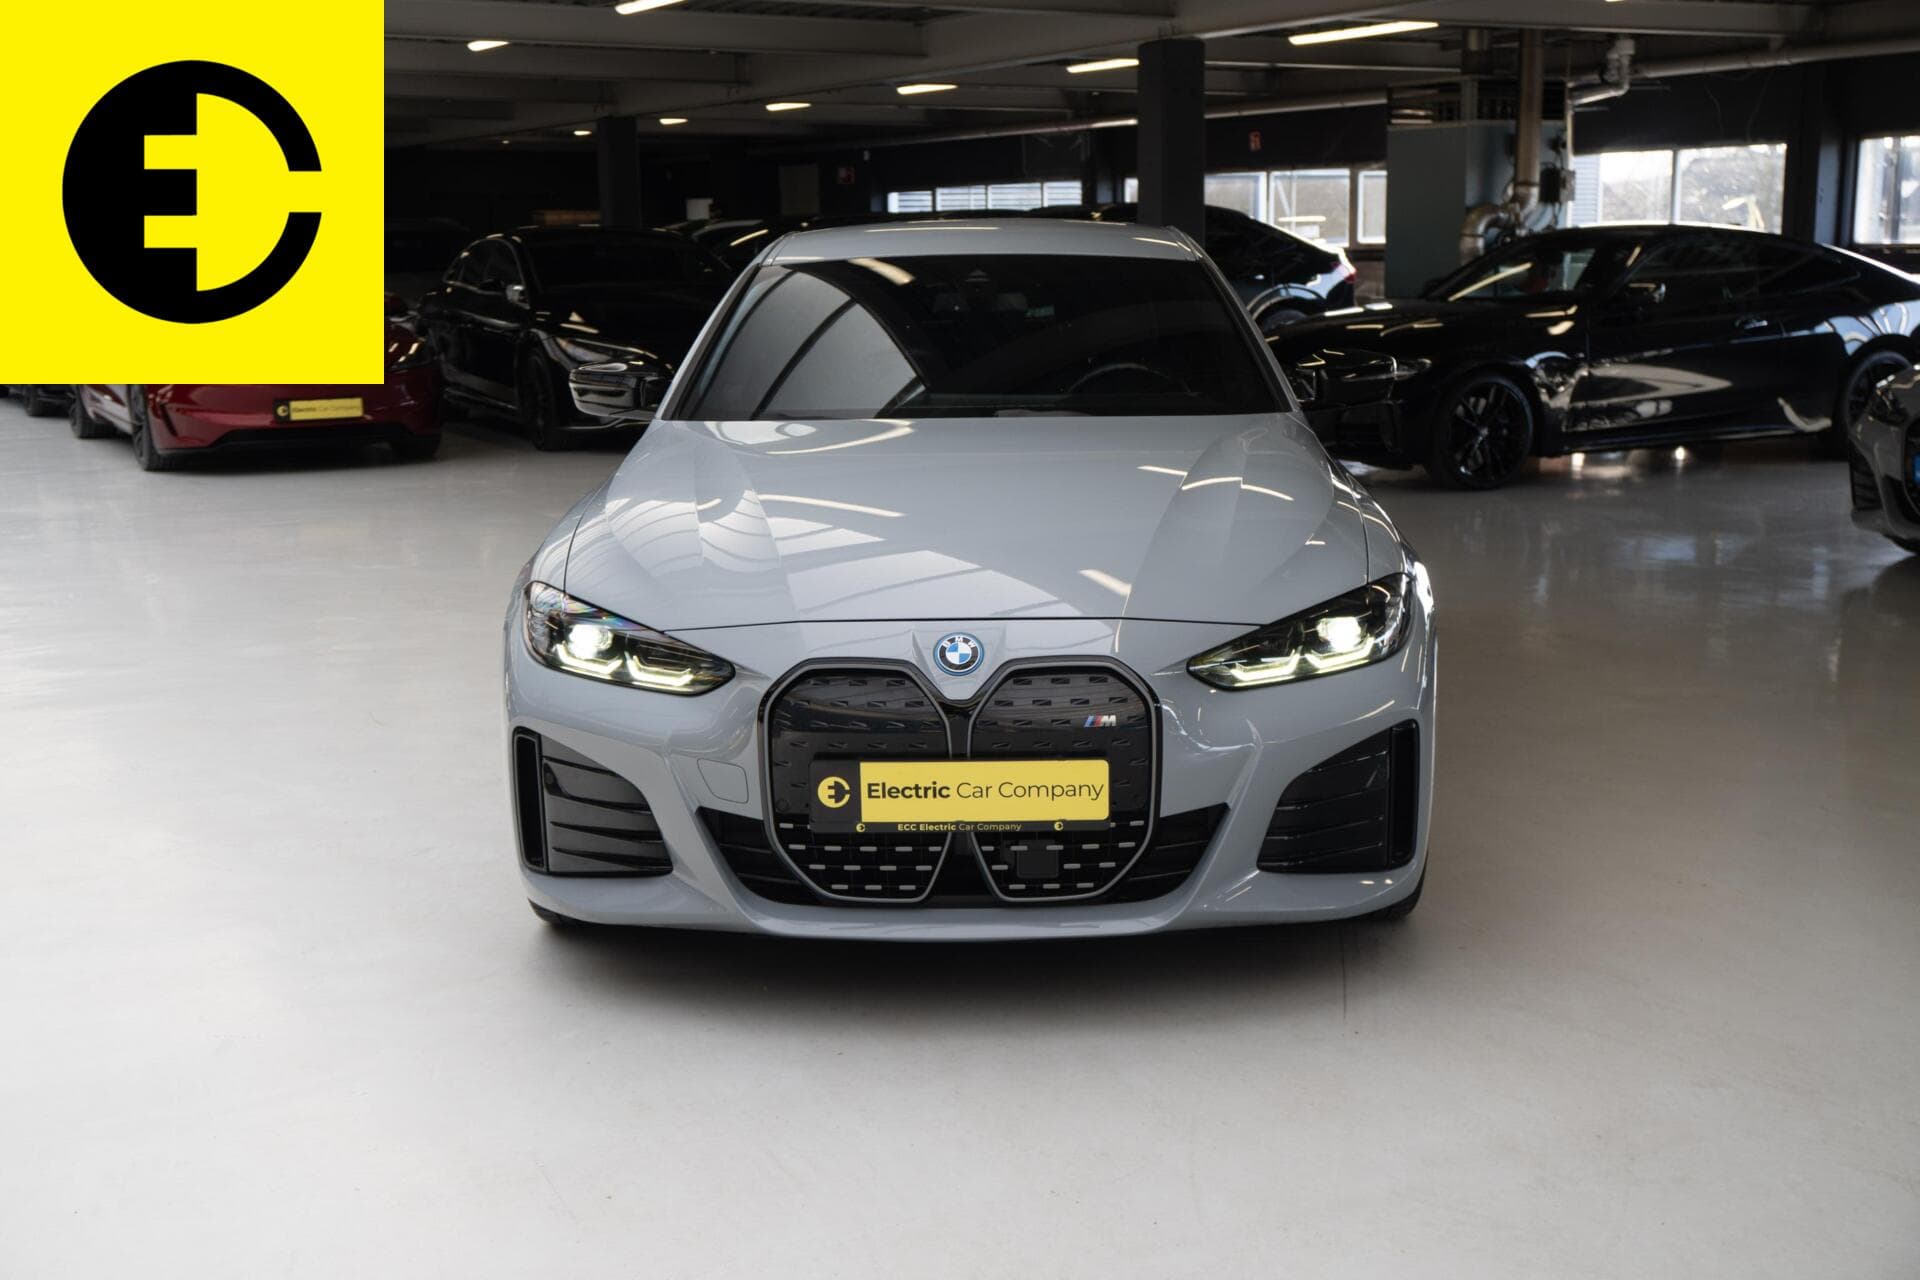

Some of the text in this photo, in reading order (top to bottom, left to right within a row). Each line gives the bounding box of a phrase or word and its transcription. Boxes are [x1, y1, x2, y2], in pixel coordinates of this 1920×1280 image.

[867, 781, 951, 799] Electric
[956, 782, 993, 799] Car
[998, 781, 1104, 802] Company
[897, 823, 1022, 832] ECC Electric Car Company
